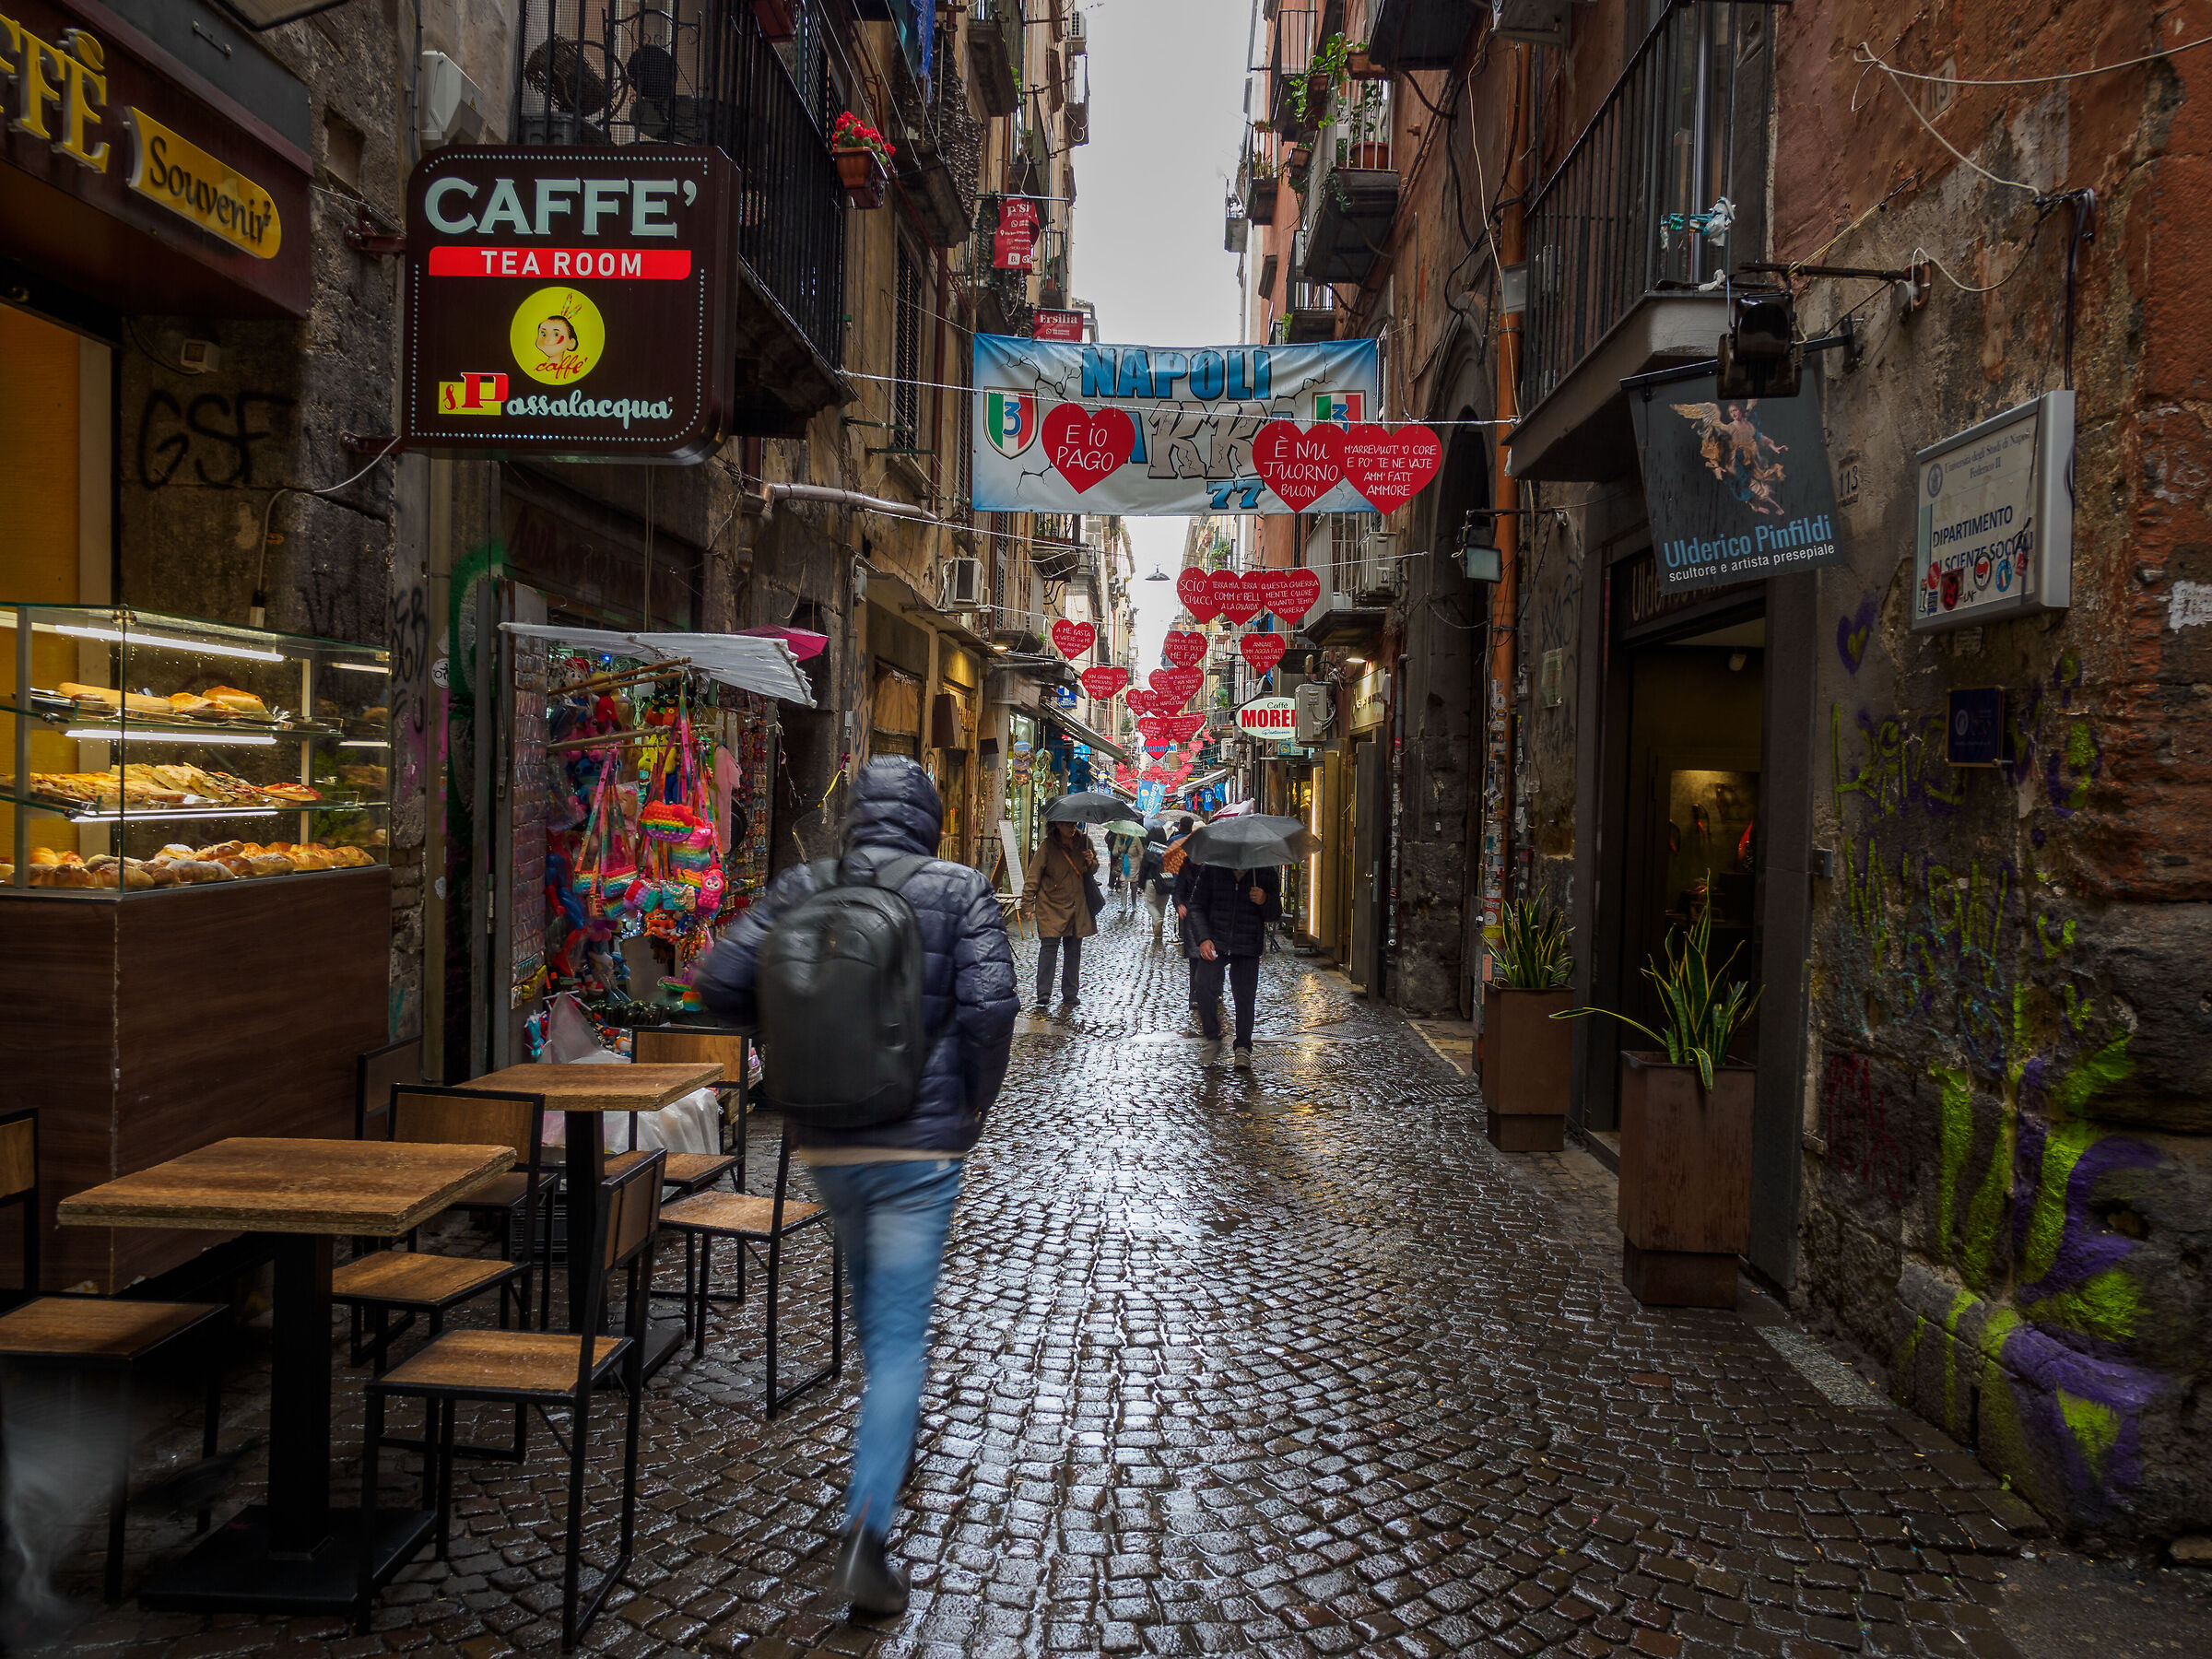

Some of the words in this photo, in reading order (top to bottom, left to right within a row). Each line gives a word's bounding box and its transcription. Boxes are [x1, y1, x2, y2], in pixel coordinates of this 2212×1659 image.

[424, 177, 697, 239] CAFFE'
[480, 250, 541, 276] TEA
[553, 252, 641, 276] ROOM
[1039, 313, 1078, 324] Ersilia
[1080, 347, 1272, 401] NAPOLI
[1296, 440, 1330, 461] NU
[1412, 444, 1438, 455] CORE
[1056, 445, 1114, 472] PAGO
[1347, 457, 1355, 468] E
[1377, 457, 1389, 468] TE
[1392, 457, 1406, 468] NE
[1387, 471, 1414, 482] FATT
[1840, 464, 1860, 497] 113
[1205, 479, 1267, 511] 77
[1280, 483, 1317, 498] BUON
[1366, 484, 1411, 497] AMMORE
[1932, 504, 2014, 549] DIPARTIMENTO
[1663, 533, 1752, 569] Ulderico
[1754, 514, 1833, 553] Pinfildi
[1668, 564, 1718, 583] scultore
[1720, 562, 1728, 573] e
[1731, 555, 1771, 572] artista
[1773, 543, 1835, 566] presepiale
[1211, 581, 1229, 590] TERRA
[1241, 581, 1258, 590] TERRA
[1261, 582, 1288, 591] QUESTA
[1288, 580, 1319, 589] GUERRA
[1265, 591, 1288, 599] MENTE
[1267, 599, 1294, 607] QUANTO
[1073, 629, 1090, 637] BASTA
[1170, 652, 1182, 660] ME
[1141, 744, 1177, 753] DECUMANI
